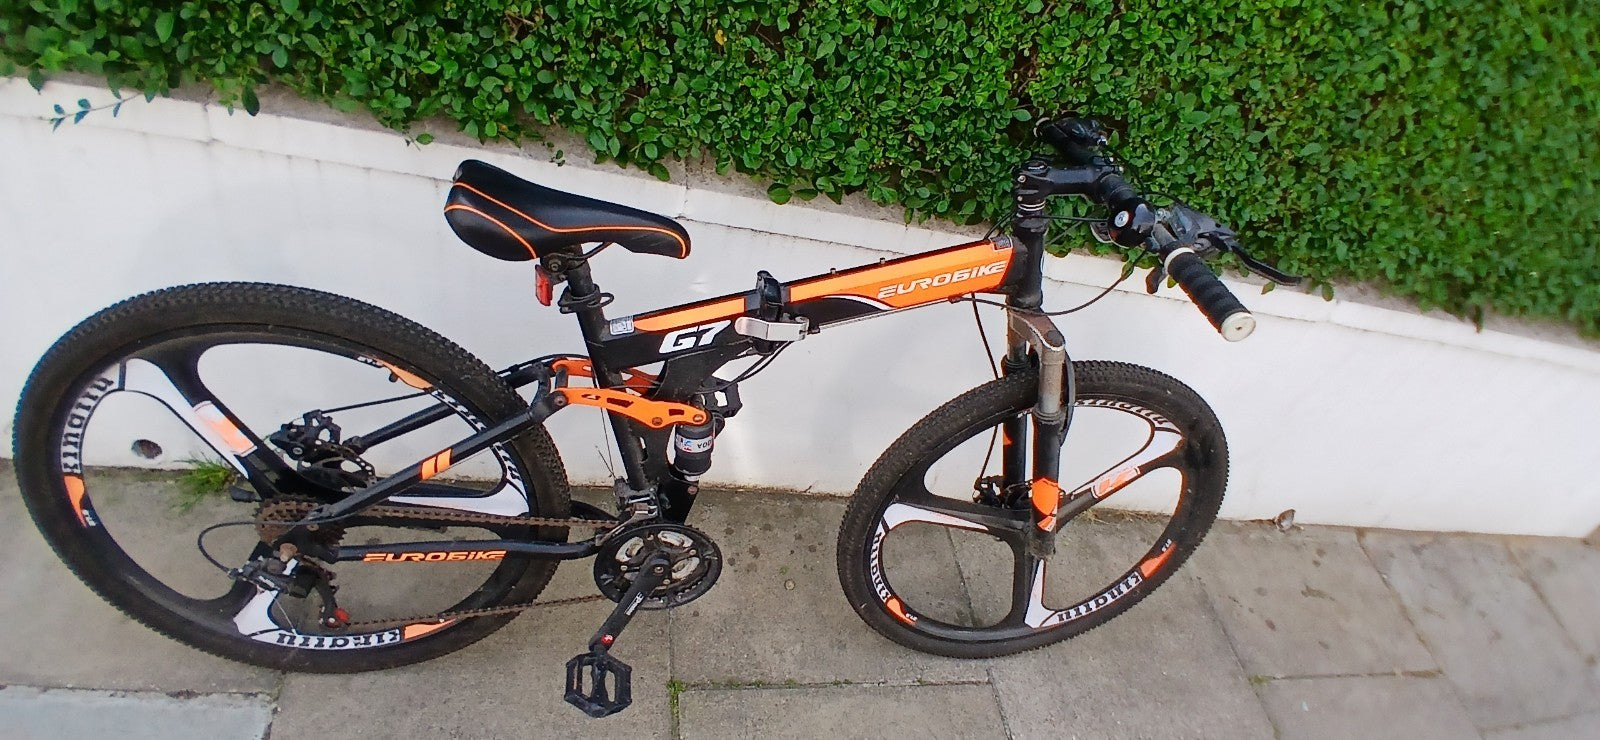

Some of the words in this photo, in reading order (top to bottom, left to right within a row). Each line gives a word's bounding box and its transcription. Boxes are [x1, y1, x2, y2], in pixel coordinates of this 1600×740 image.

[877, 261, 1008, 299] EUROBIKE
[659, 320, 731, 354] G7
[364, 550, 507, 562] EUROBIKE
